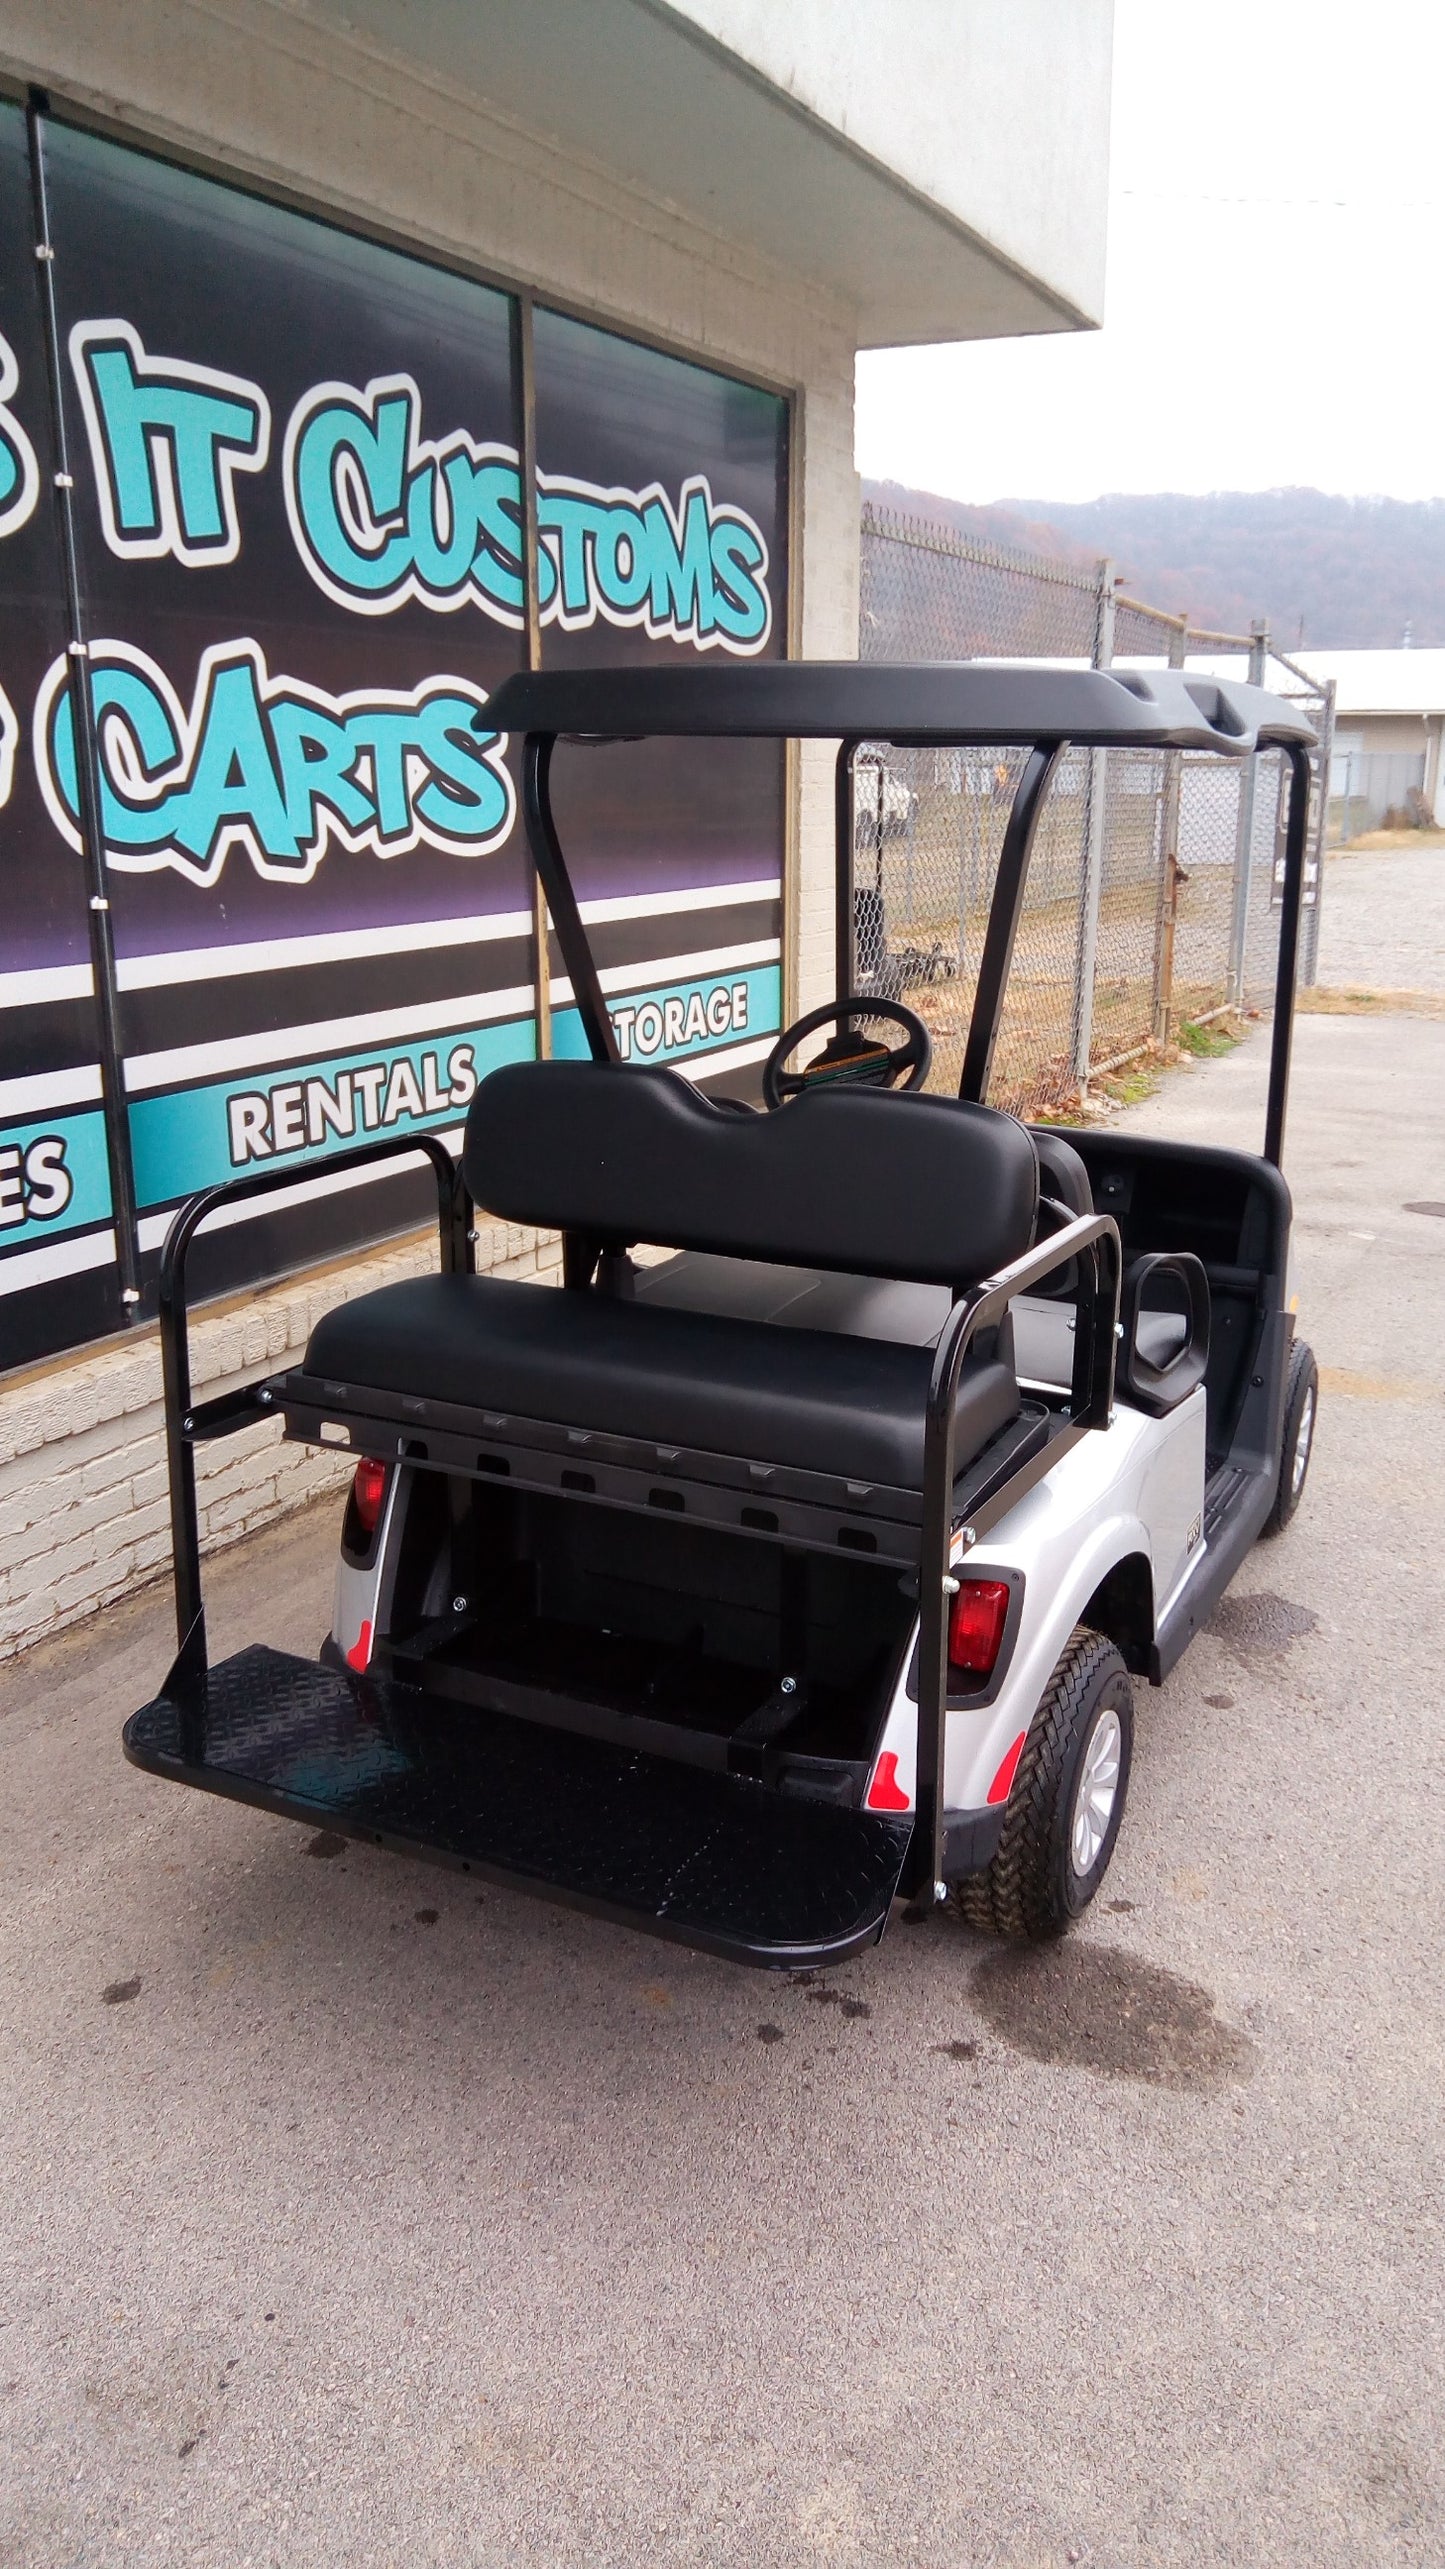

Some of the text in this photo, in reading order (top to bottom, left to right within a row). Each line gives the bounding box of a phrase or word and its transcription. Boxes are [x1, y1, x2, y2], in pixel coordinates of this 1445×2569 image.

[72, 322, 266, 562] IT
[286, 378, 769, 651] CUSTOMS
[37, 642, 512, 882] CARTS
[226, 1043, 477, 1167] RENTALS
[609, 982, 748, 1060] TORAGE
